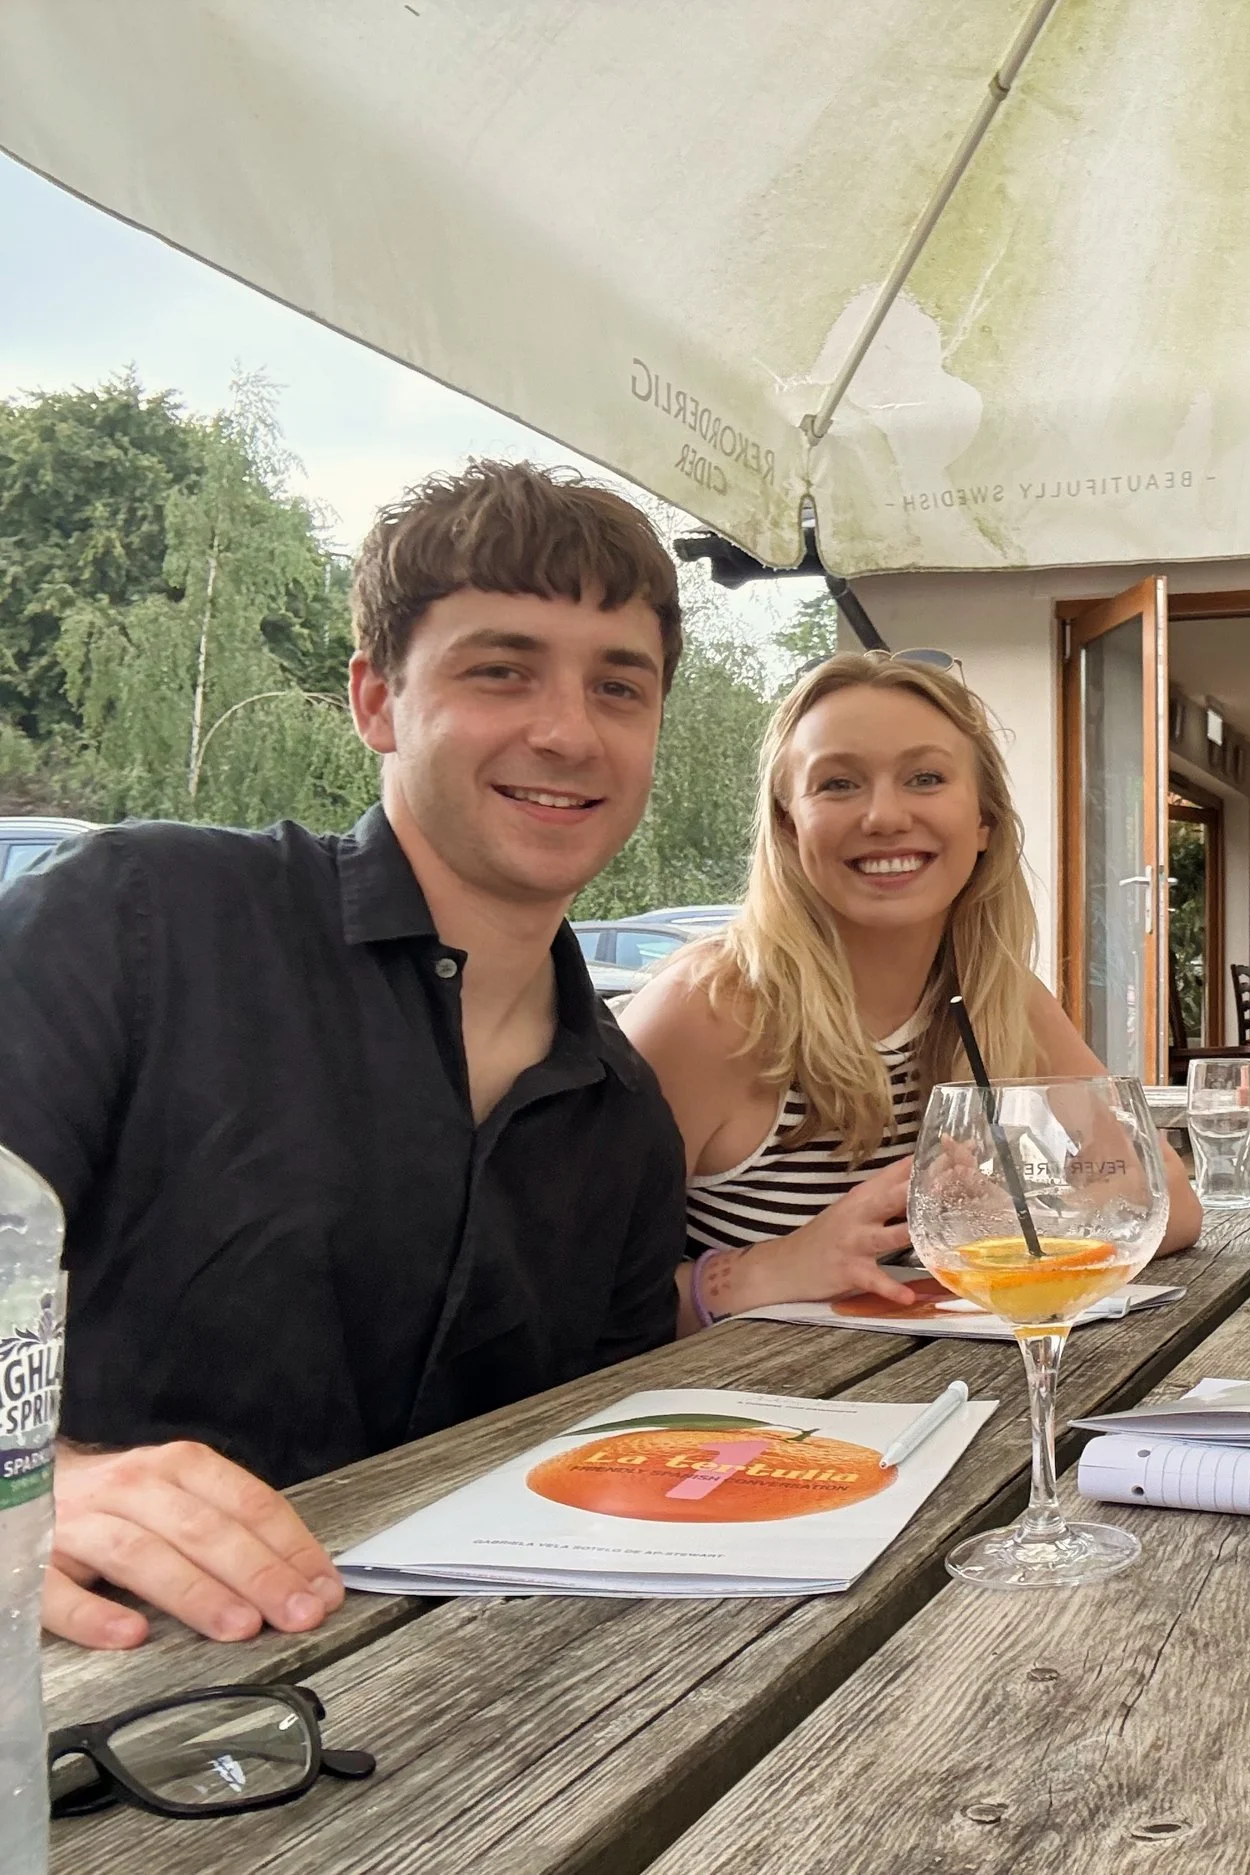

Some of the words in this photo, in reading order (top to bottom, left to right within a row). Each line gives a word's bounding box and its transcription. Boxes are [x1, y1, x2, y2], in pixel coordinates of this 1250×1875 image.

[3, 1452, 51, 1479] SPARK
[569, 1465, 646, 1475] FRIENDLY
[649, 1469, 722, 1482] SPANISH
[723, 1477, 850, 1492] CONVERSATION
[583, 1451, 649, 1466] La
[665, 1453, 859, 1483] tertulia
